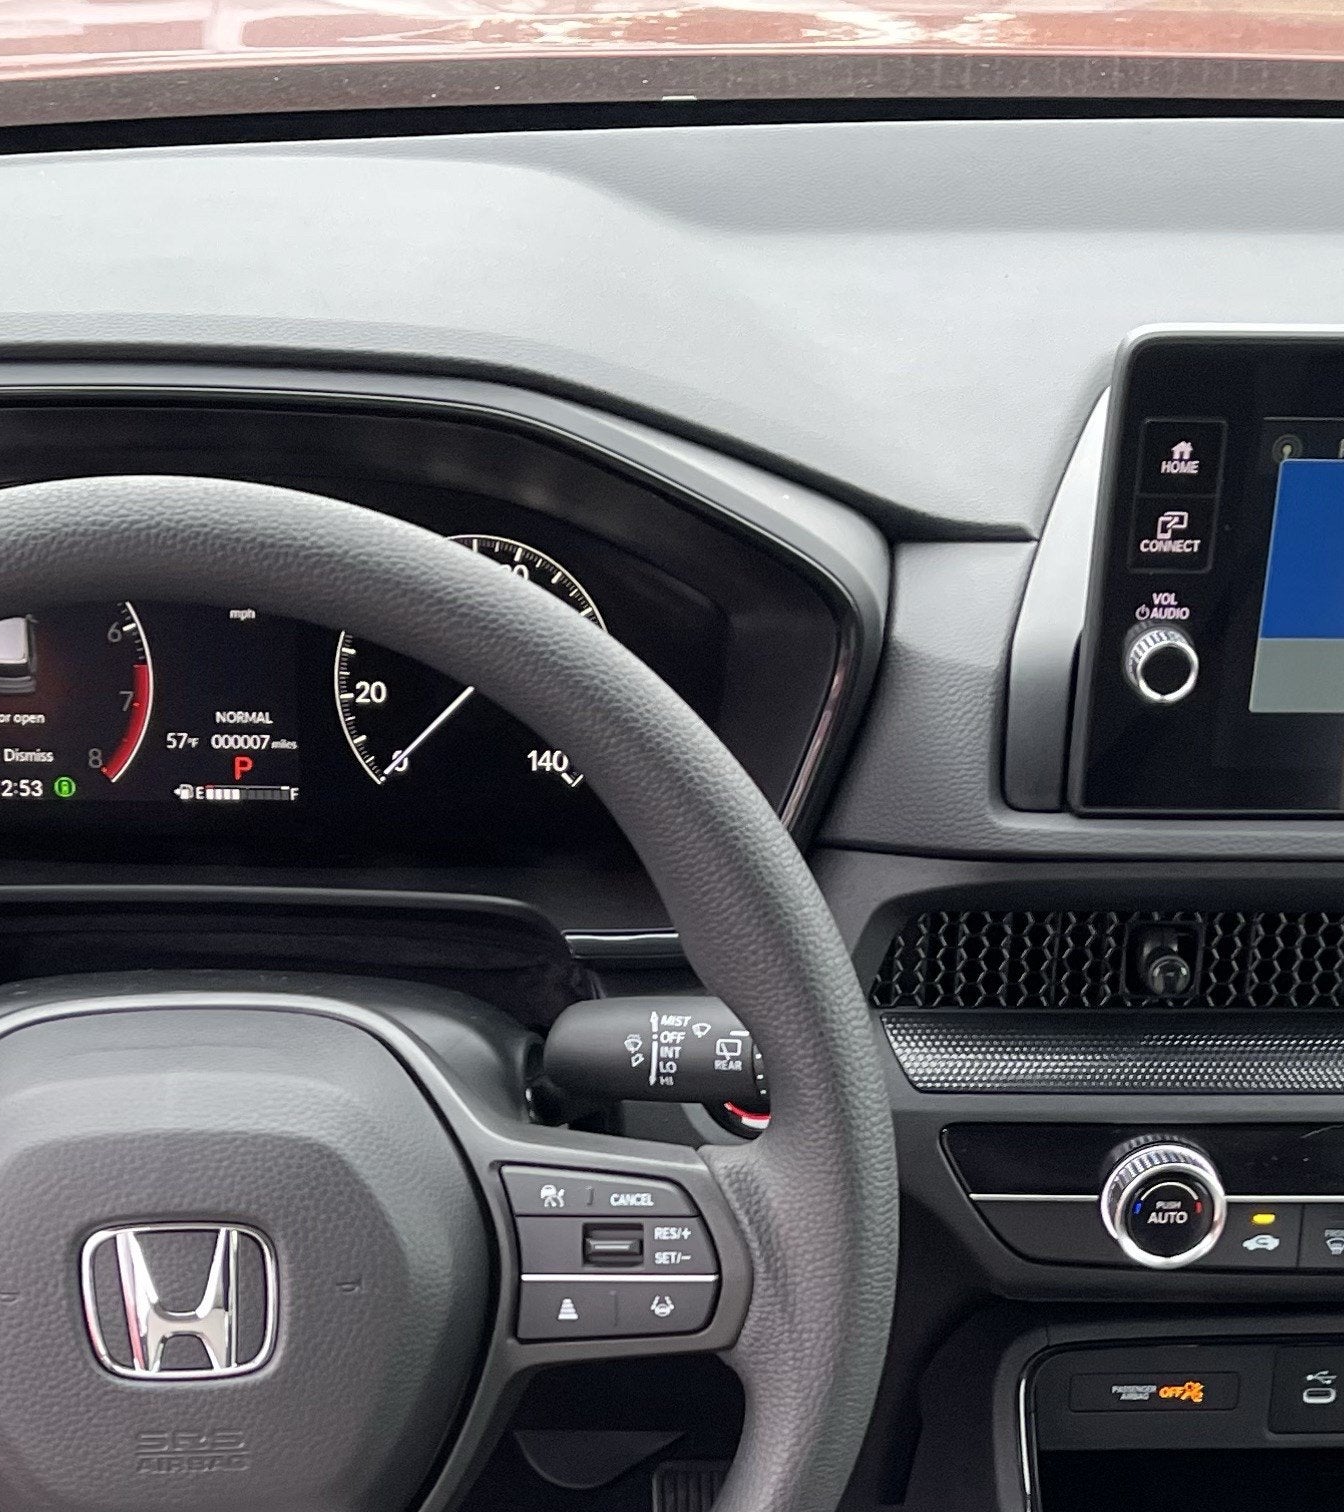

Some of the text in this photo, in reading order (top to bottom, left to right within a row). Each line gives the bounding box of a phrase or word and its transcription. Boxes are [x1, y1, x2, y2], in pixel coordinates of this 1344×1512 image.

[1160, 460, 1200, 474] HOME
[1140, 539, 1201, 552] CONNECT
[1152, 592, 1178, 605] VOL
[229, 608, 256, 621] mph
[1150, 606, 1191, 620] AUDIO
[107, 621, 122, 643] 6
[355, 681, 387, 703] 20
[119, 690, 134, 711] 7
[13, 714, 46, 726] open
[215, 711, 273, 724] NORMAL
[211, 734, 270, 750] 000007
[4, 748, 54, 762] Dismiss
[88, 748, 103, 768] 8
[527, 749, 570, 771] 140
[234, 756, 253, 780] P
[195, 788, 205, 800] E
[290, 787, 299, 800] F
[660, 1014, 692, 1027] MIST
[659, 1030, 686, 1044] OFF
[659, 1045, 682, 1059] INT
[659, 1060, 677, 1074] LO
[714, 1060, 743, 1072] REAR
[610, 1192, 654, 1207] CANCEL
[1146, 1210, 1189, 1224] AUTO
